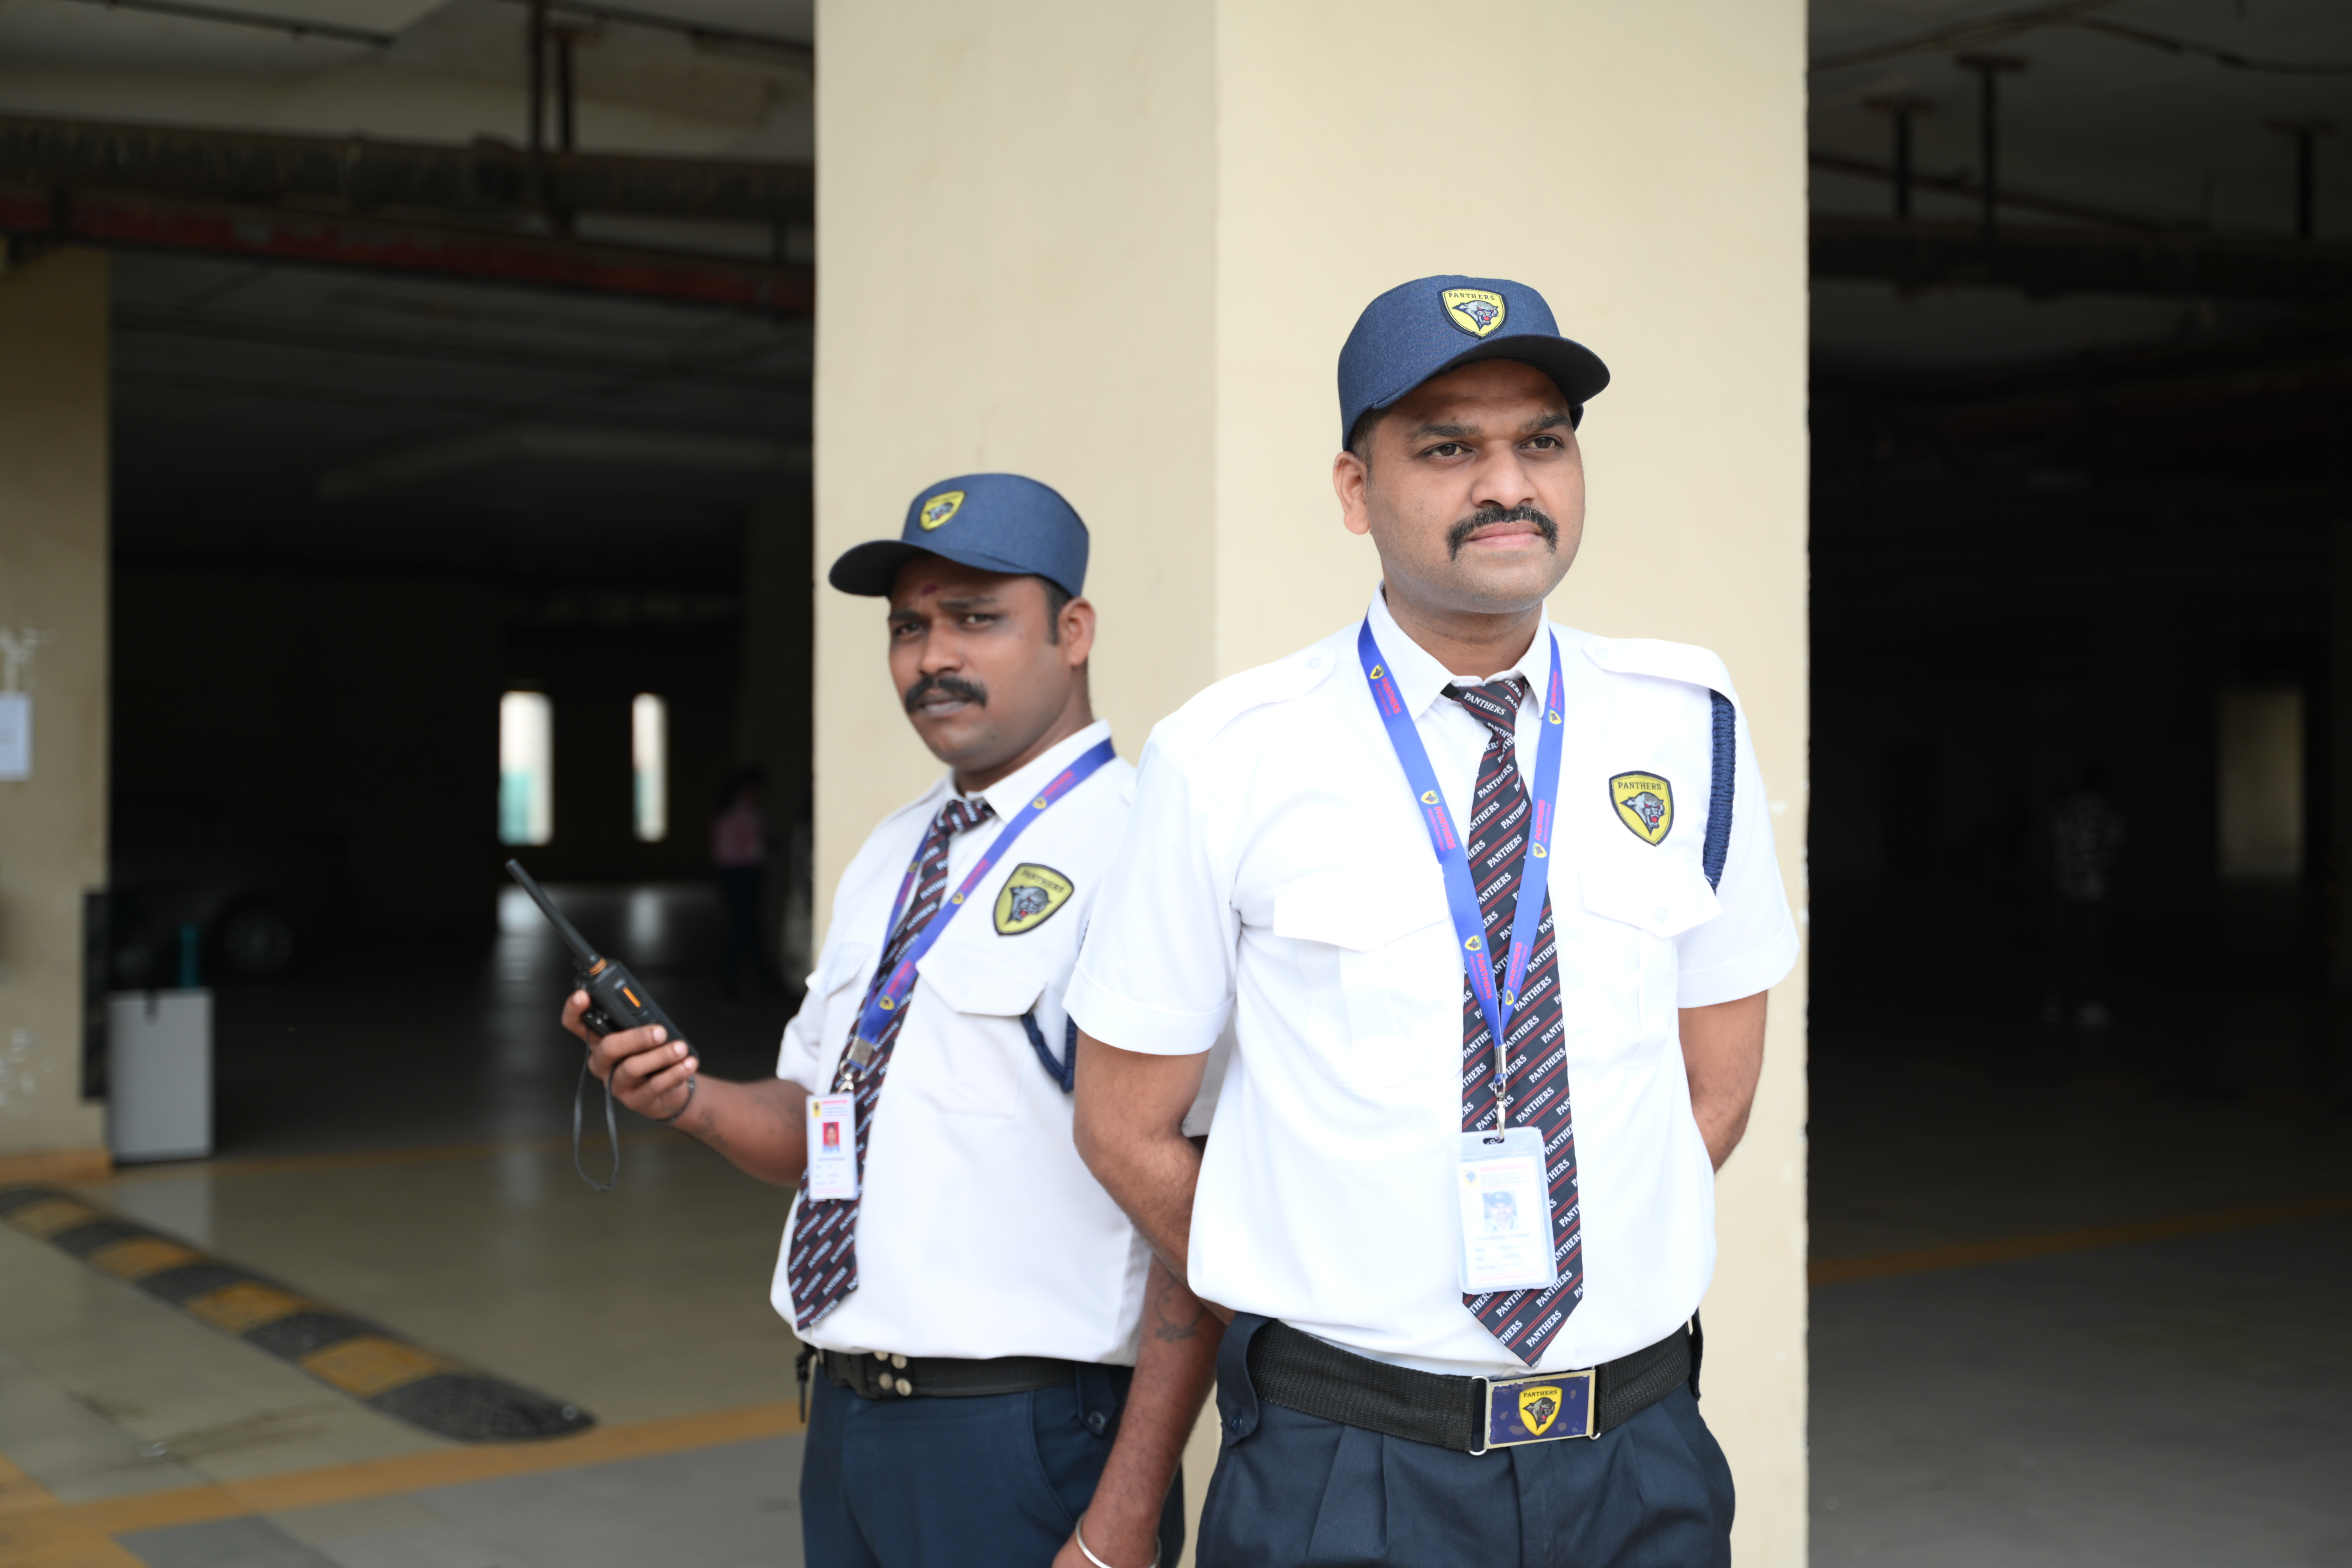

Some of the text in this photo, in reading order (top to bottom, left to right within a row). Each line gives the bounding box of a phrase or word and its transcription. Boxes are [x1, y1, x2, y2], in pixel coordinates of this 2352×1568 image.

[1381, 677, 1402, 714] PANTHERS
[1464, 692, 1506, 715] PANTHERS
[1478, 764, 1514, 798] PANTHERS
[1617, 782, 1662, 790] PANTHERS
[1434, 806, 1456, 849] PANTHERS
[1501, 799, 1527, 829] PANTHERS
[1535, 799, 1545, 840] PANTHERS
[1487, 834, 1522, 868] PANTHERS
[1476, 953, 1492, 999] PANTHERS
[1508, 942, 1522, 987] PANTHERS
[1514, 976, 1552, 1012] PANTHERS
[1463, 1029, 1492, 1059] PANTHE
[1488, 1054, 1527, 1091] PHERS
[1529, 1047, 1566, 1083] PANTHERS
[1476, 1095, 1514, 1131] PANTRS
[1516, 1087, 1554, 1123] PANTHERS
[1536, 1270, 1572, 1307] PANTHERS
[1499, 1320, 1522, 1344] THERS
[1526, 1310, 1562, 1347] PANTHERS
